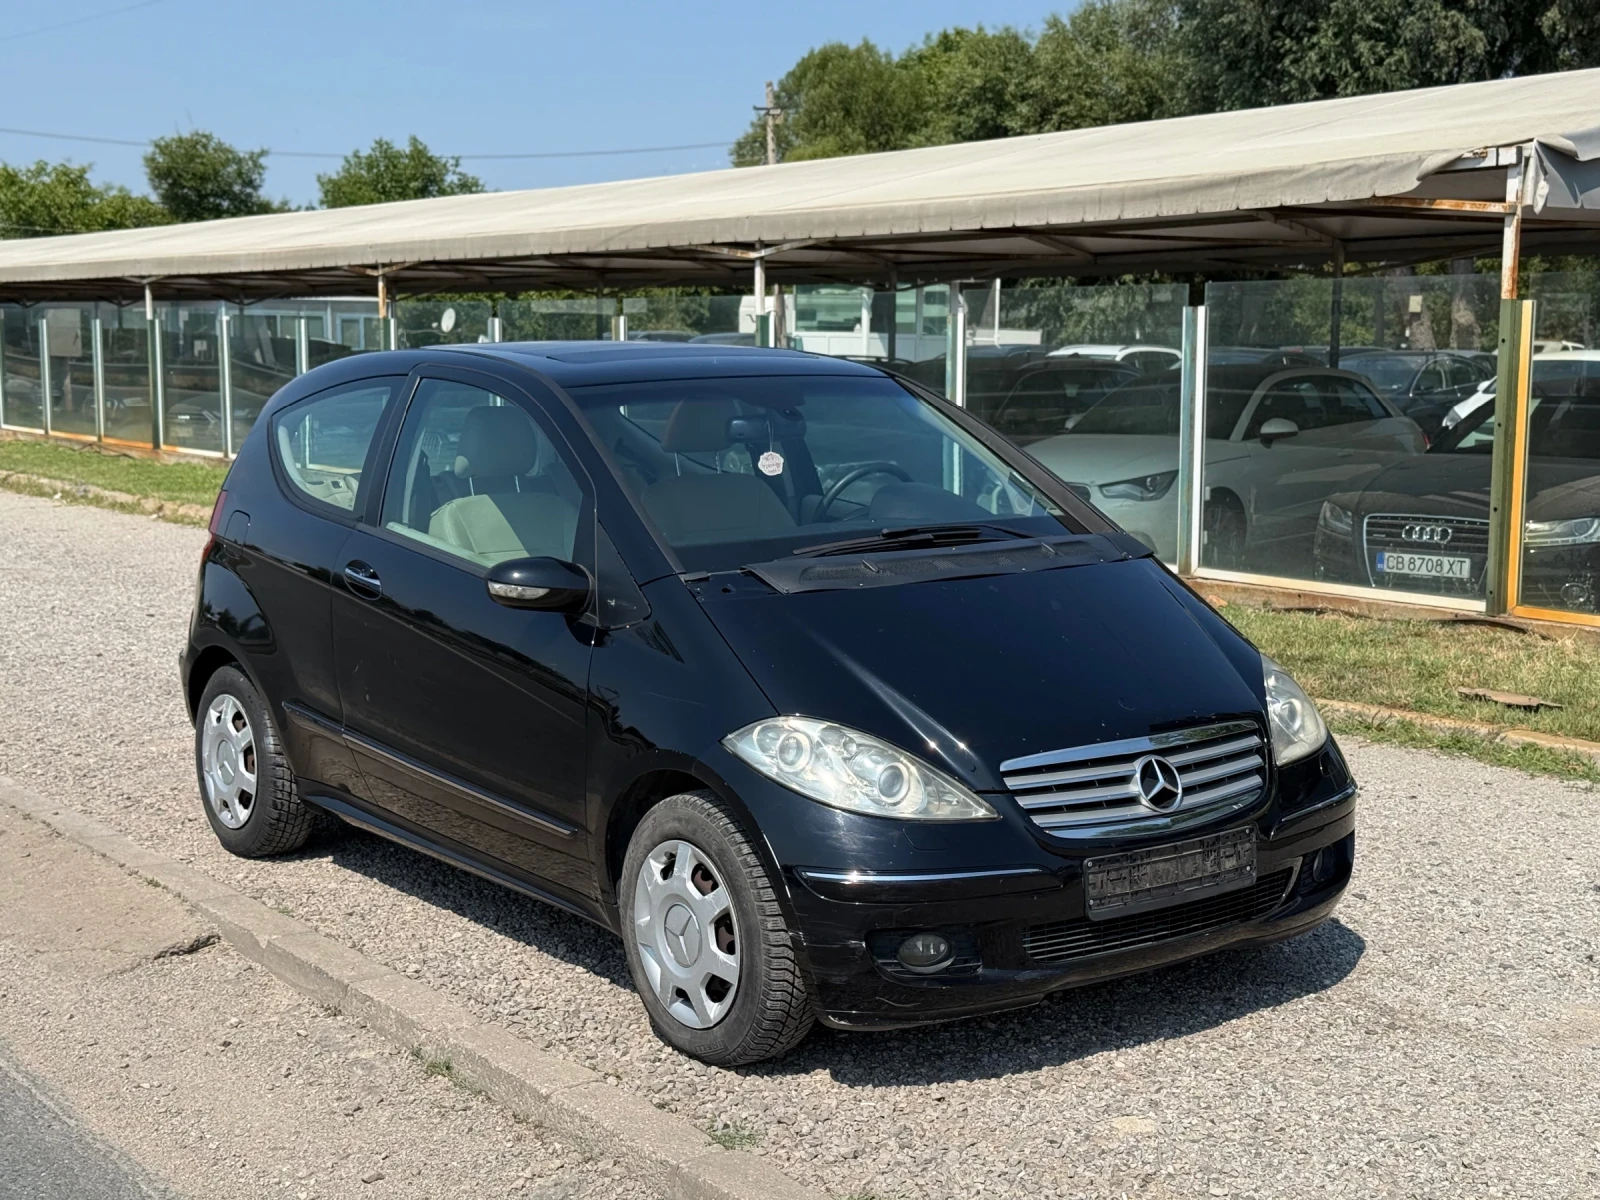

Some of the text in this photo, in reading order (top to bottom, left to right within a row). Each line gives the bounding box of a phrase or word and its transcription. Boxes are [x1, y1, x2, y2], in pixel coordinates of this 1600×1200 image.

[1386, 555, 1466, 575] CB 8708 XT
